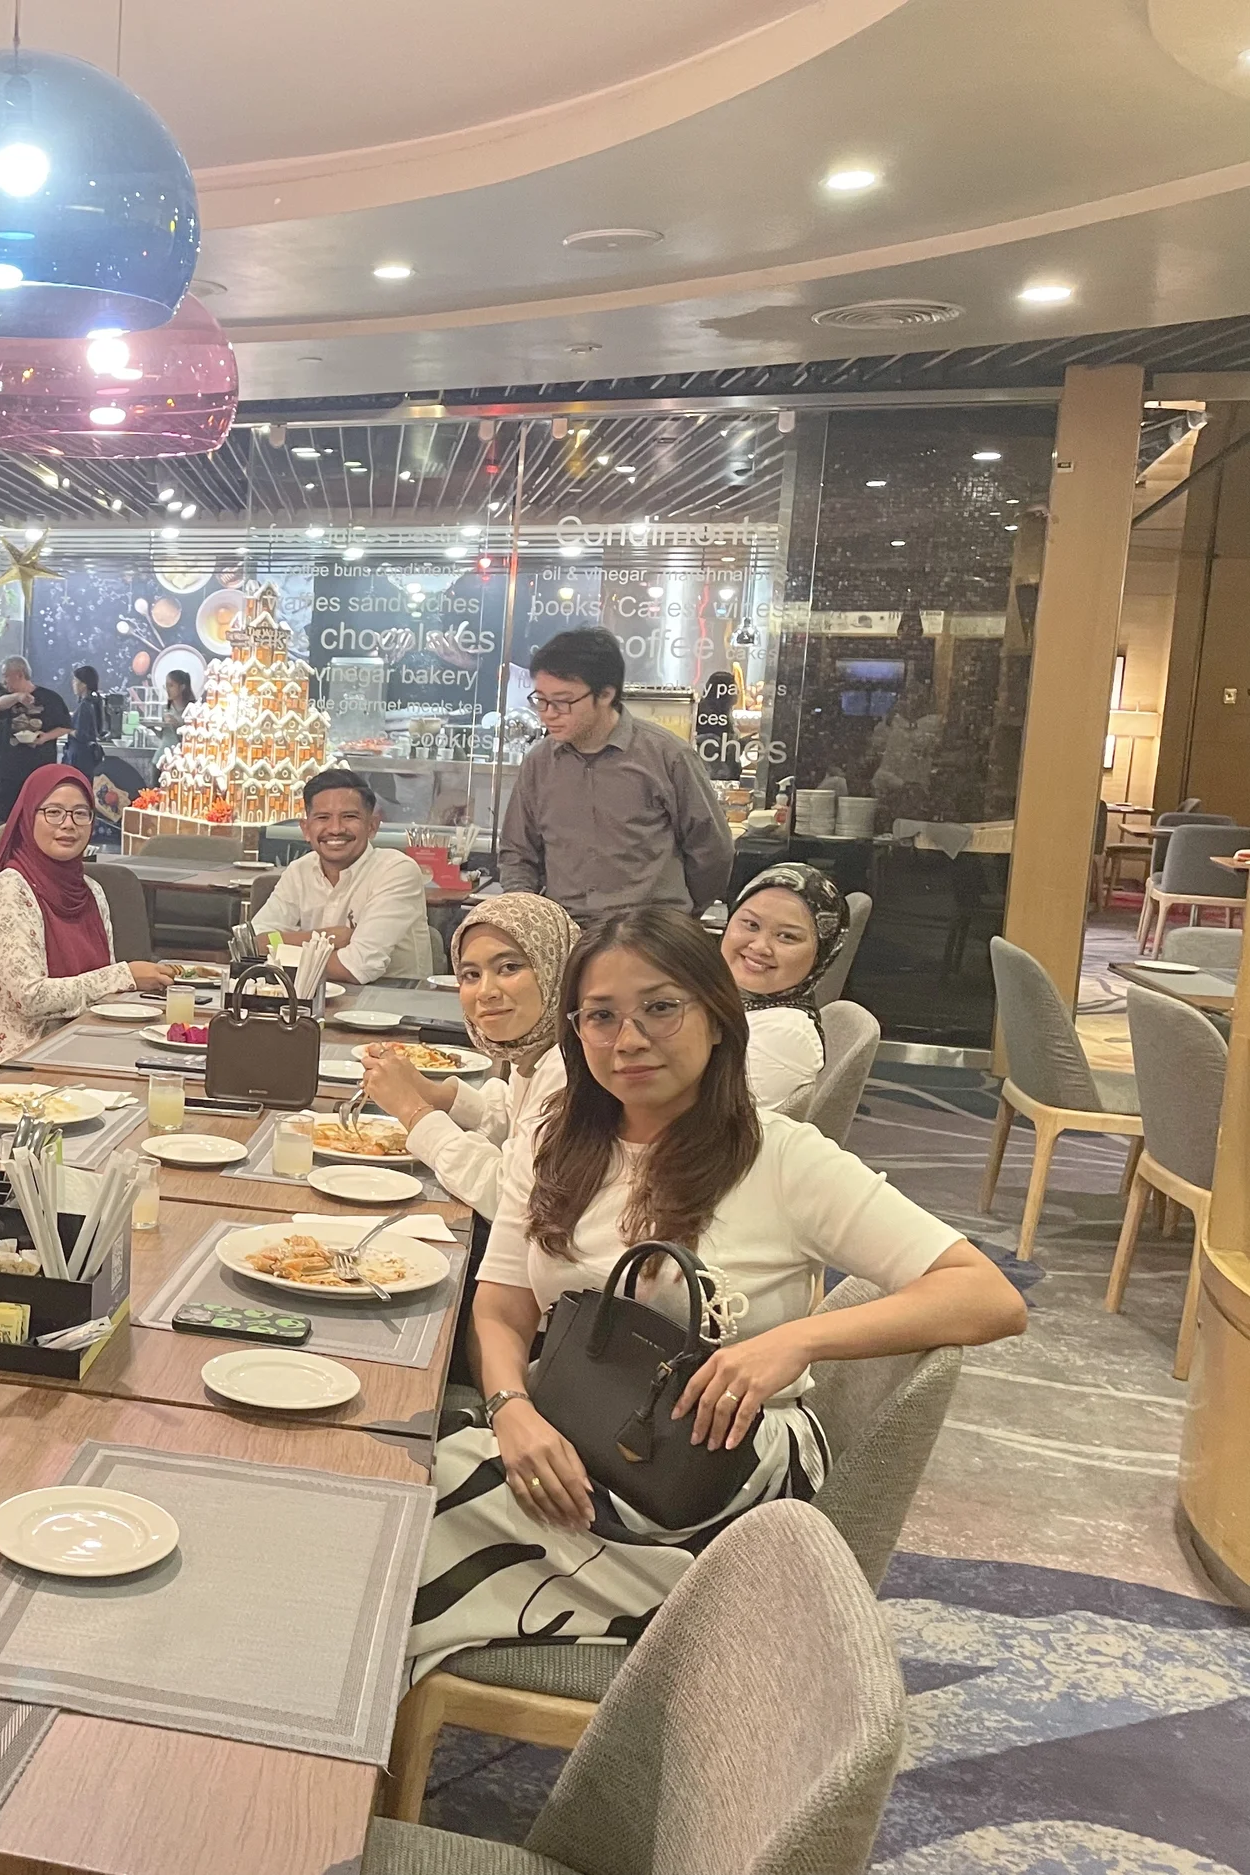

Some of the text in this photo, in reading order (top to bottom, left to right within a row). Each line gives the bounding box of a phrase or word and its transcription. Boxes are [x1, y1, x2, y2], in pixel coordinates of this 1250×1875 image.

[334, 563, 371, 577] buns
[542, 567, 647, 585] oil & vinegar
[531, 594, 601, 616] books
[320, 621, 496, 652] chocolates
[725, 647, 779, 661] cakes
[313, 664, 478, 690] vinegar bakery
[339, 698, 402, 713] gourmet
[406, 700, 453, 714] meals
[458, 702, 483, 714] tea
[410, 729, 495, 749] cookies
